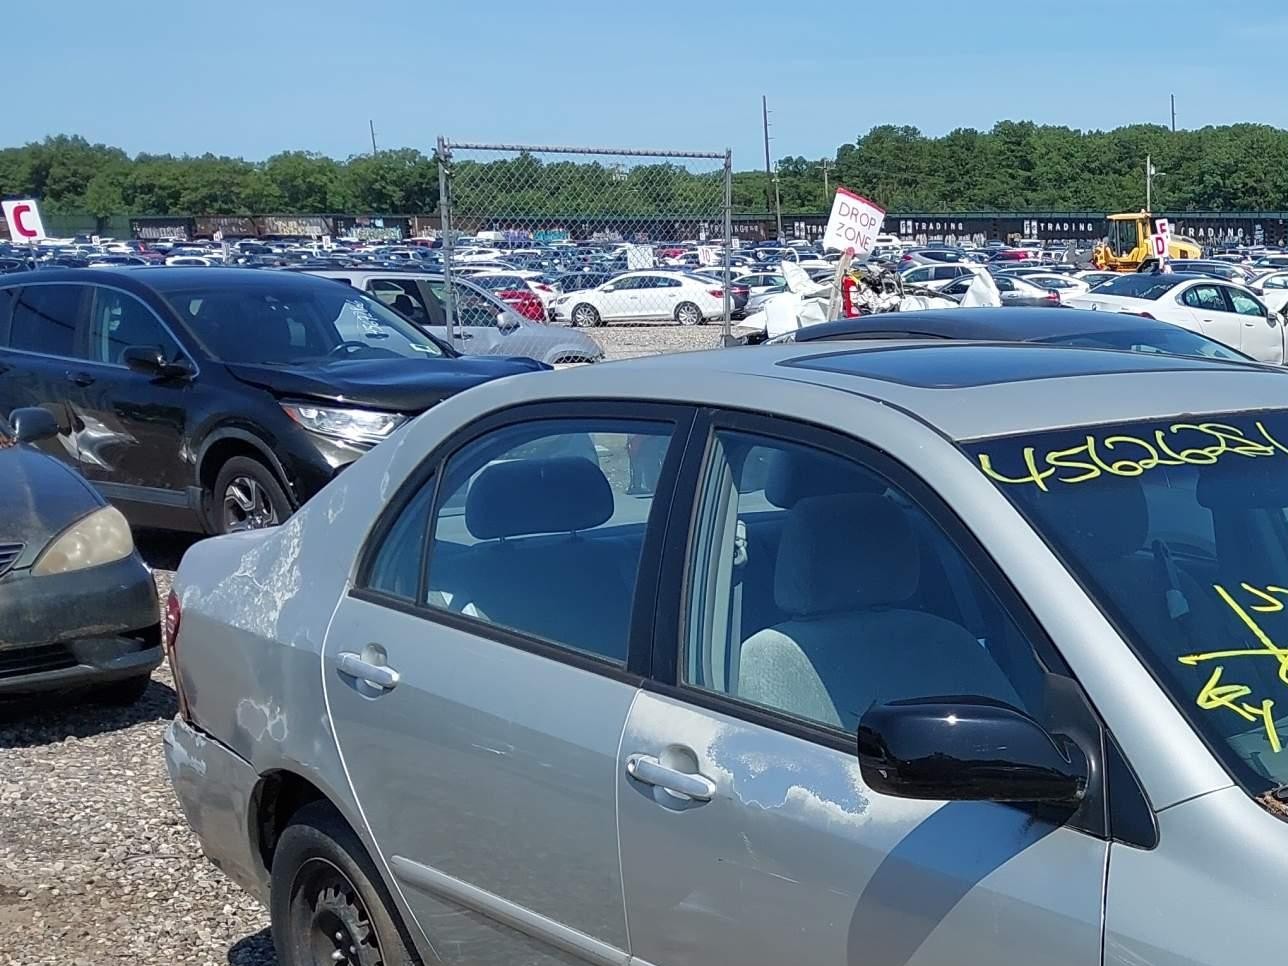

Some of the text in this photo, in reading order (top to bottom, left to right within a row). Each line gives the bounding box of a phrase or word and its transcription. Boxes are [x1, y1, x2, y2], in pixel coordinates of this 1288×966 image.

[13, 205, 37, 237] C
[838, 202, 877, 229] DROP
[915, 222, 963, 231] TRADING
[1039, 222, 1093, 232] TRADING
[835, 222, 872, 252] ZONE
[1155, 236, 1165, 255] D
